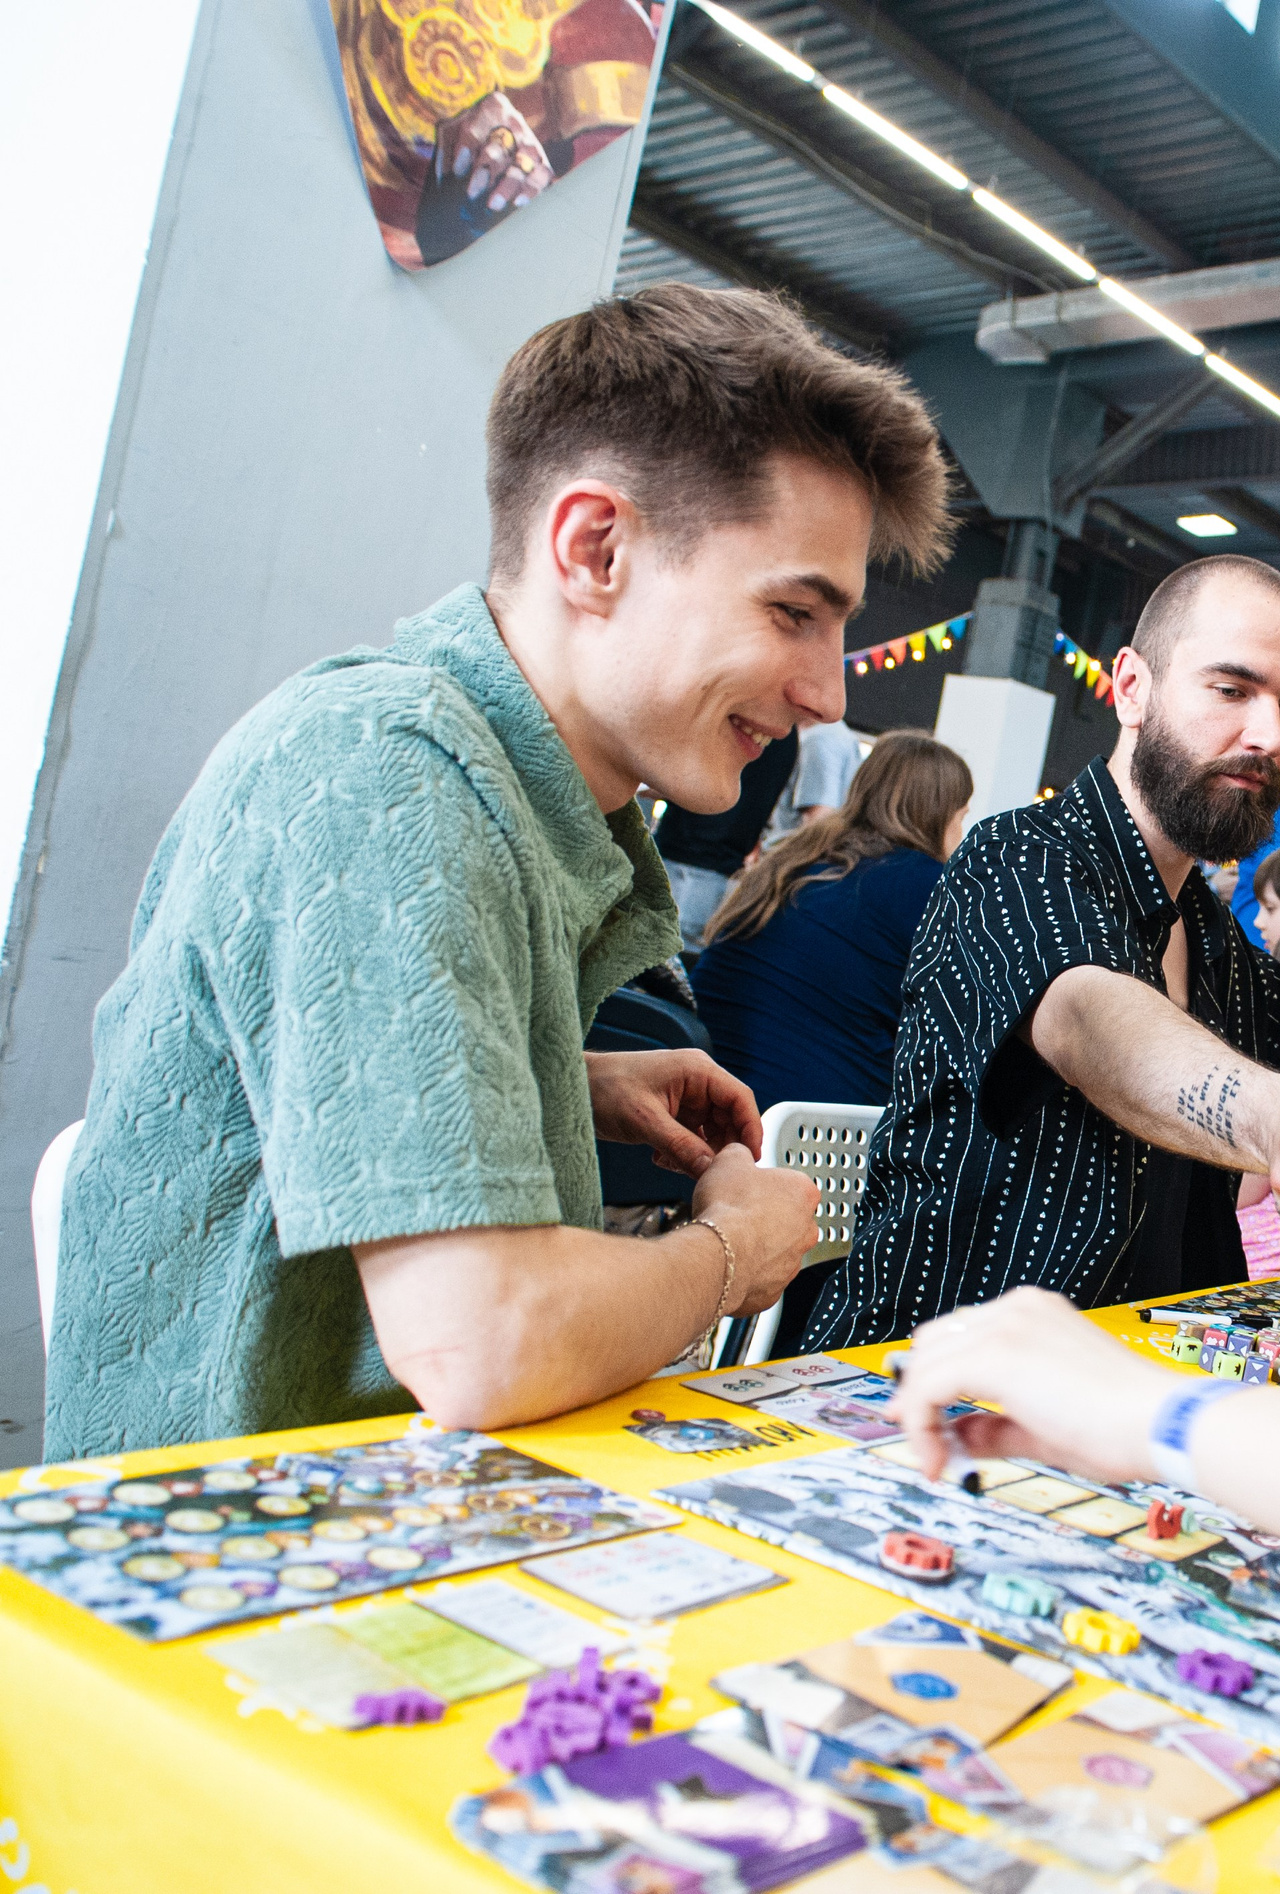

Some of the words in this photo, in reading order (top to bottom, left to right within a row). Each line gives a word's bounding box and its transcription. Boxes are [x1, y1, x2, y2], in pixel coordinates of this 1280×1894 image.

[1200, 1066, 1219, 1101] WHAT
[1230, 1079, 1241, 1099] IT
[1187, 1084, 1199, 1122] LIFE
[1196, 1110, 1205, 1130] IS
[1206, 1106, 1216, 1135] OUR
